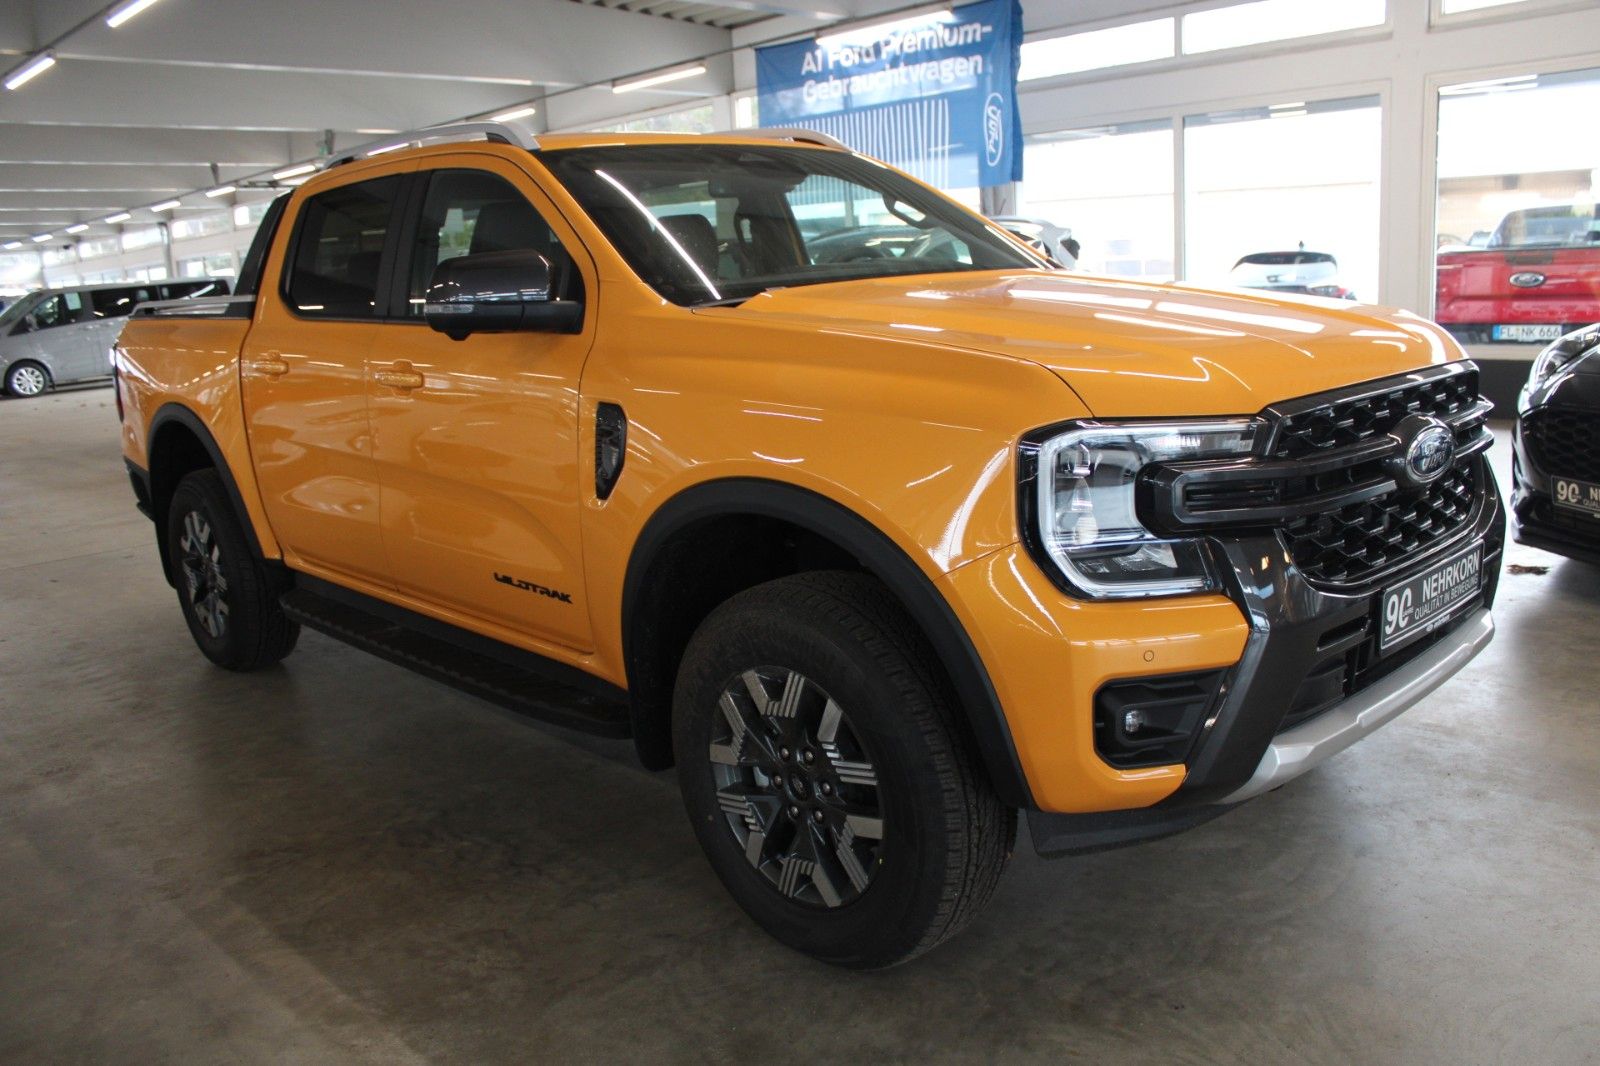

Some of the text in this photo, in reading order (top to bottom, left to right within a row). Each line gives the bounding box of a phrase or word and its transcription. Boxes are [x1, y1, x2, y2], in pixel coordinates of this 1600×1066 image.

[801, 51, 823, 75] A1
[802, 54, 983, 101] Gebrauchtwagen
[1539, 327, 1560, 337] 666
[1422, 549, 1480, 603] NEHRKORN
